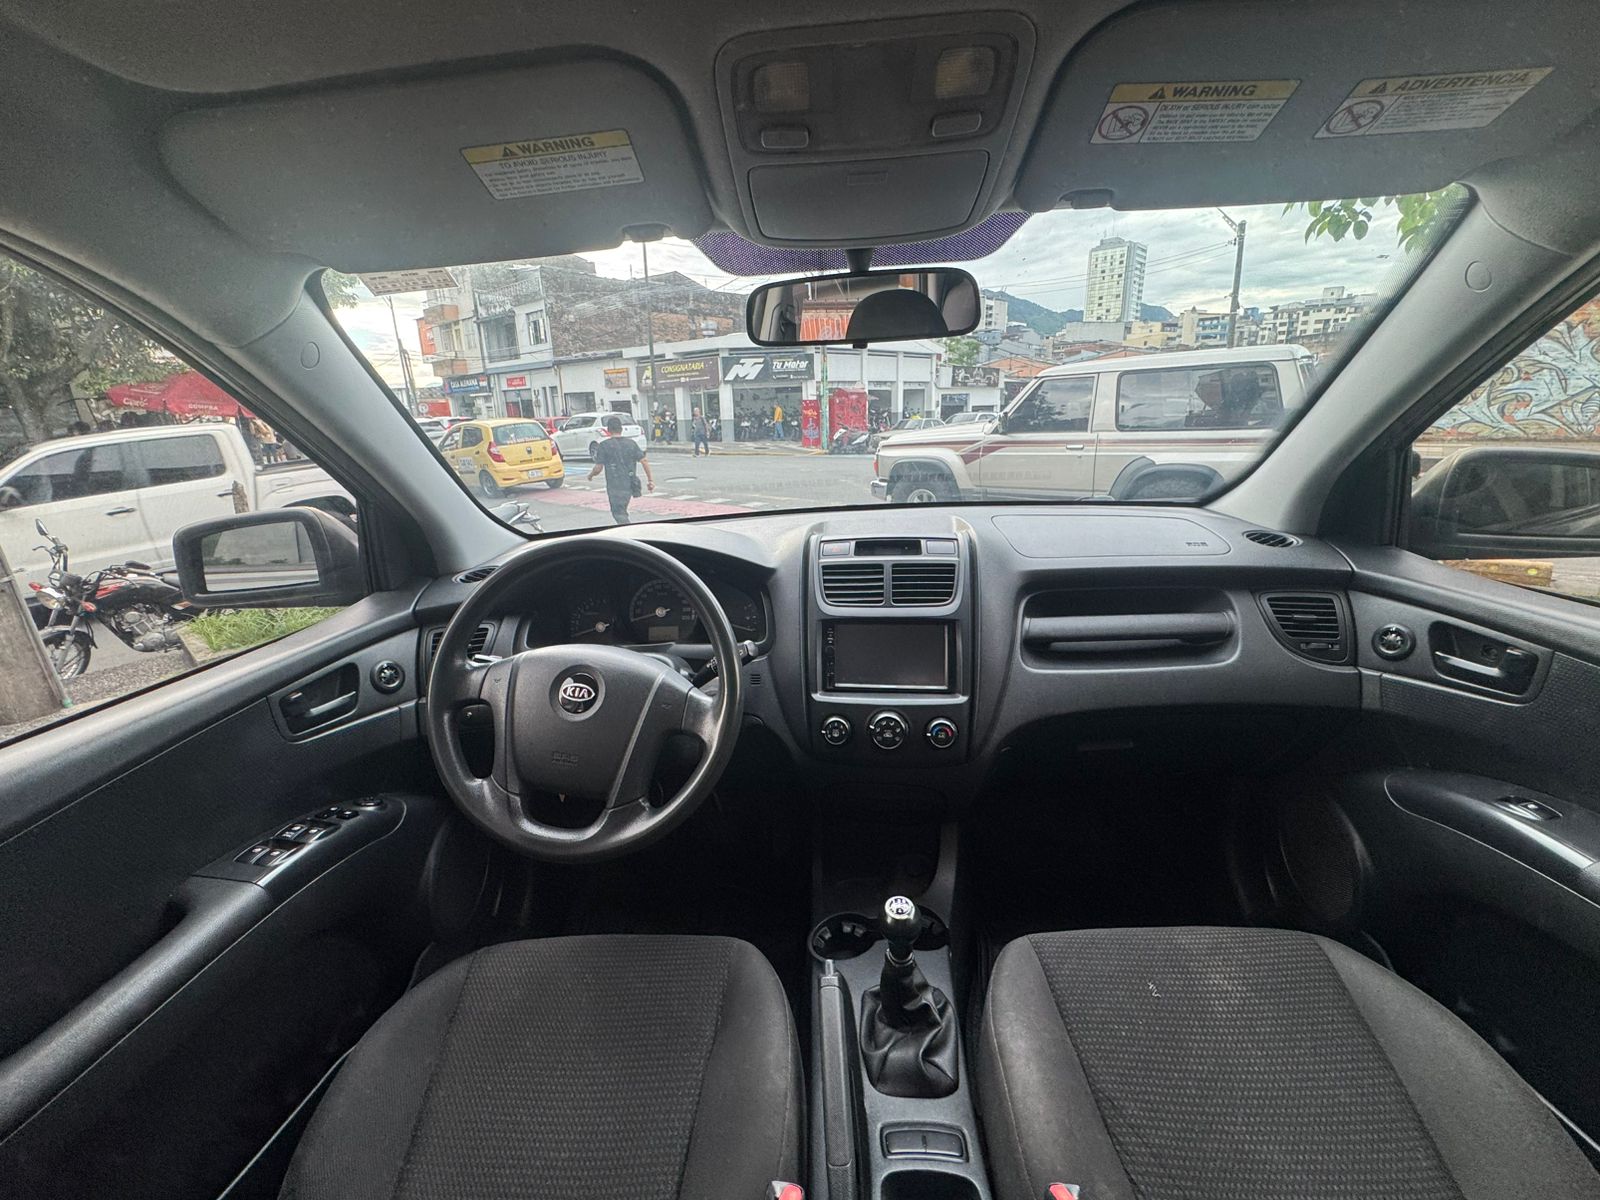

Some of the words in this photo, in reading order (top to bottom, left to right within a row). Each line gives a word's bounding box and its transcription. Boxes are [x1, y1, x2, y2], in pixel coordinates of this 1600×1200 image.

[1172, 84, 1258, 98] WARNING
[1391, 72, 1531, 93] ADVERTENCIA
[517, 137, 595, 155] WARNING
[500, 161, 512, 170] TO
[512, 158, 538, 169] AVOID
[540, 155, 577, 166] SERIOUS
[577, 151, 608, 162] INJURY
[566, 686, 588, 699] KIA
